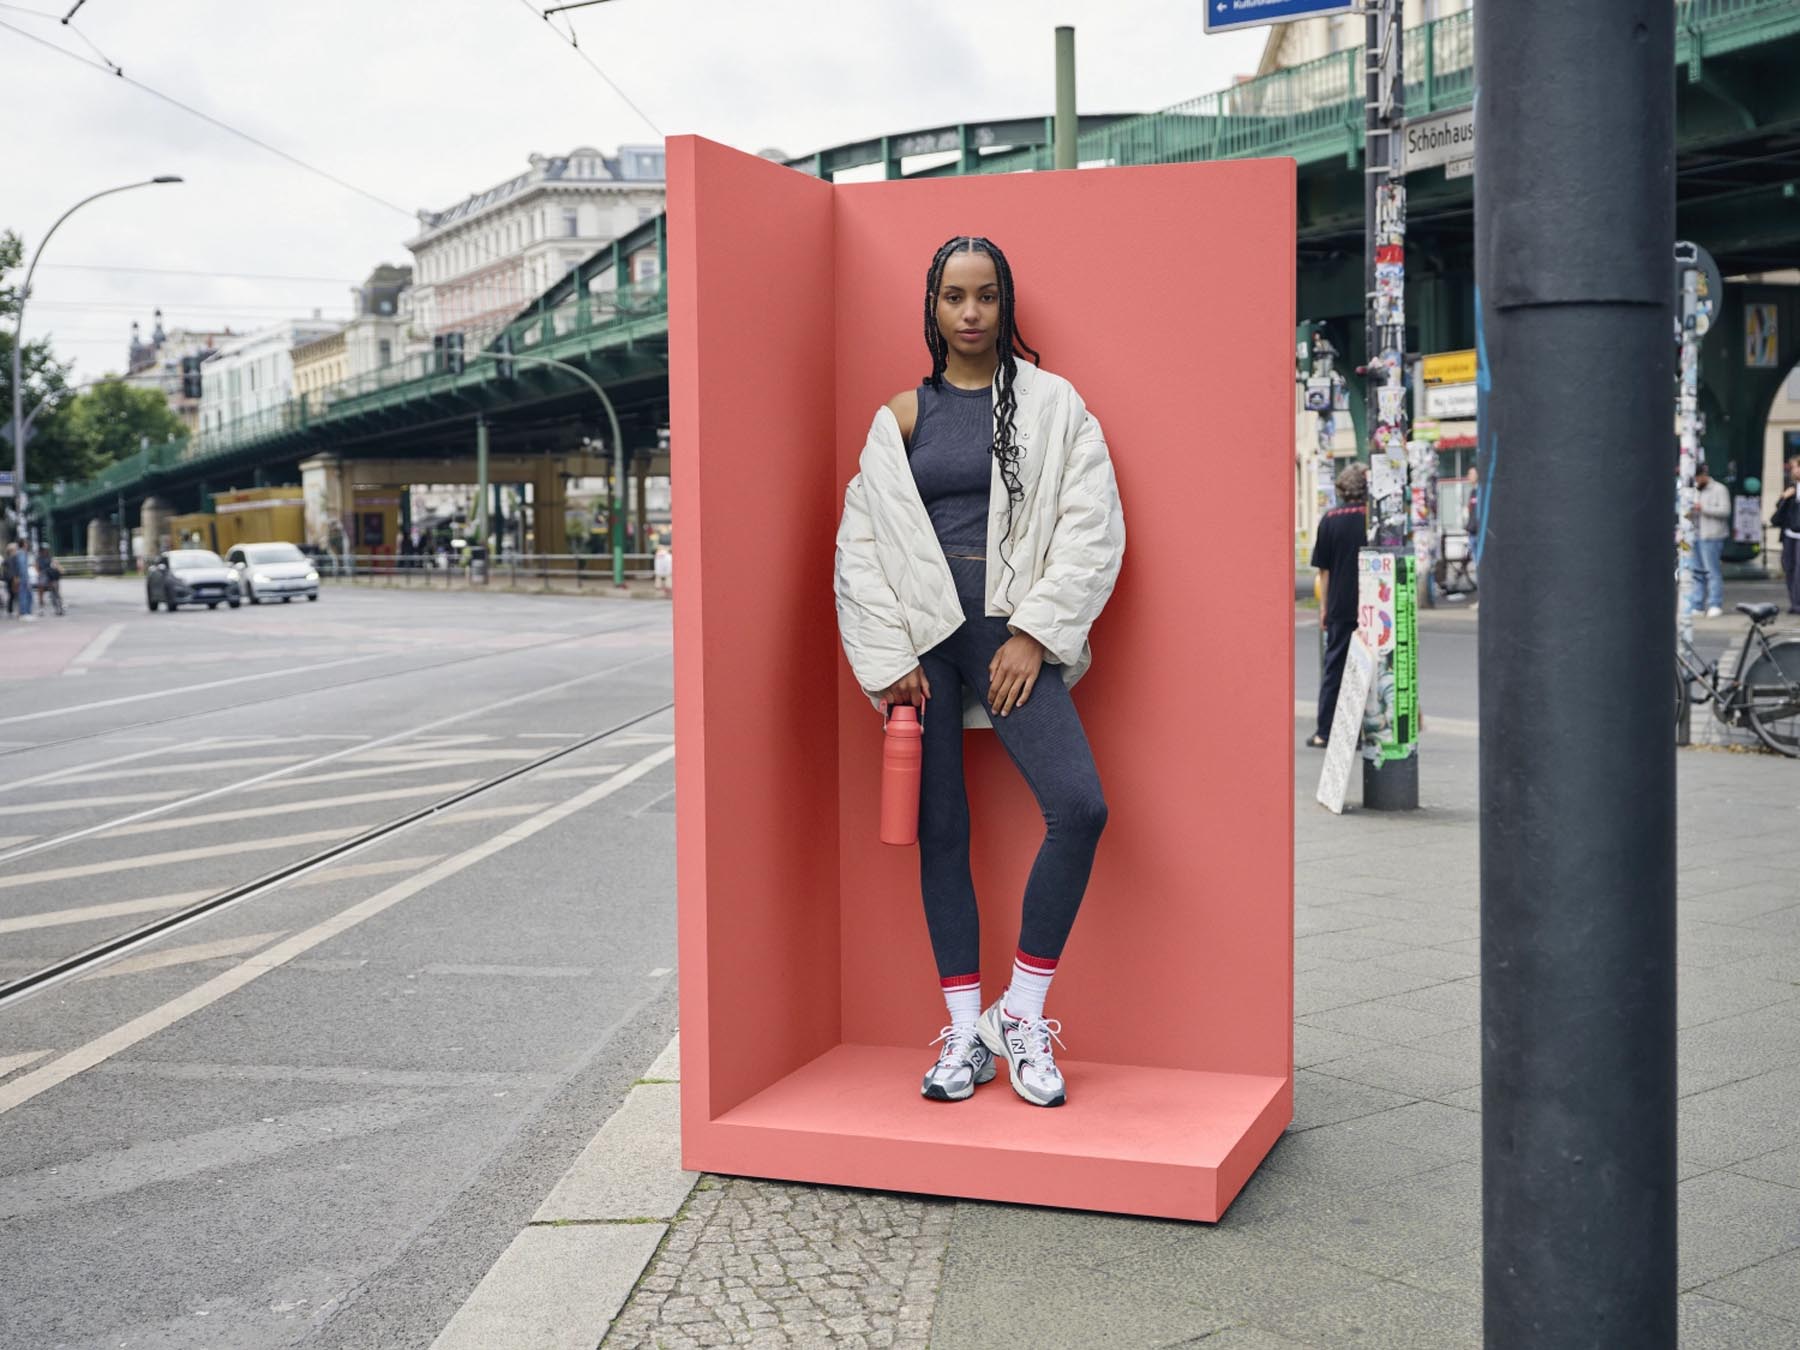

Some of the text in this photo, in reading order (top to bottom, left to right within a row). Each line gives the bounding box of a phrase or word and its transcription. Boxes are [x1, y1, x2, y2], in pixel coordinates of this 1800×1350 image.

[1408, 121, 1475, 154] Schönhaus
[1010, 1038, 1026, 1055] N
[970, 1049, 984, 1068] N
